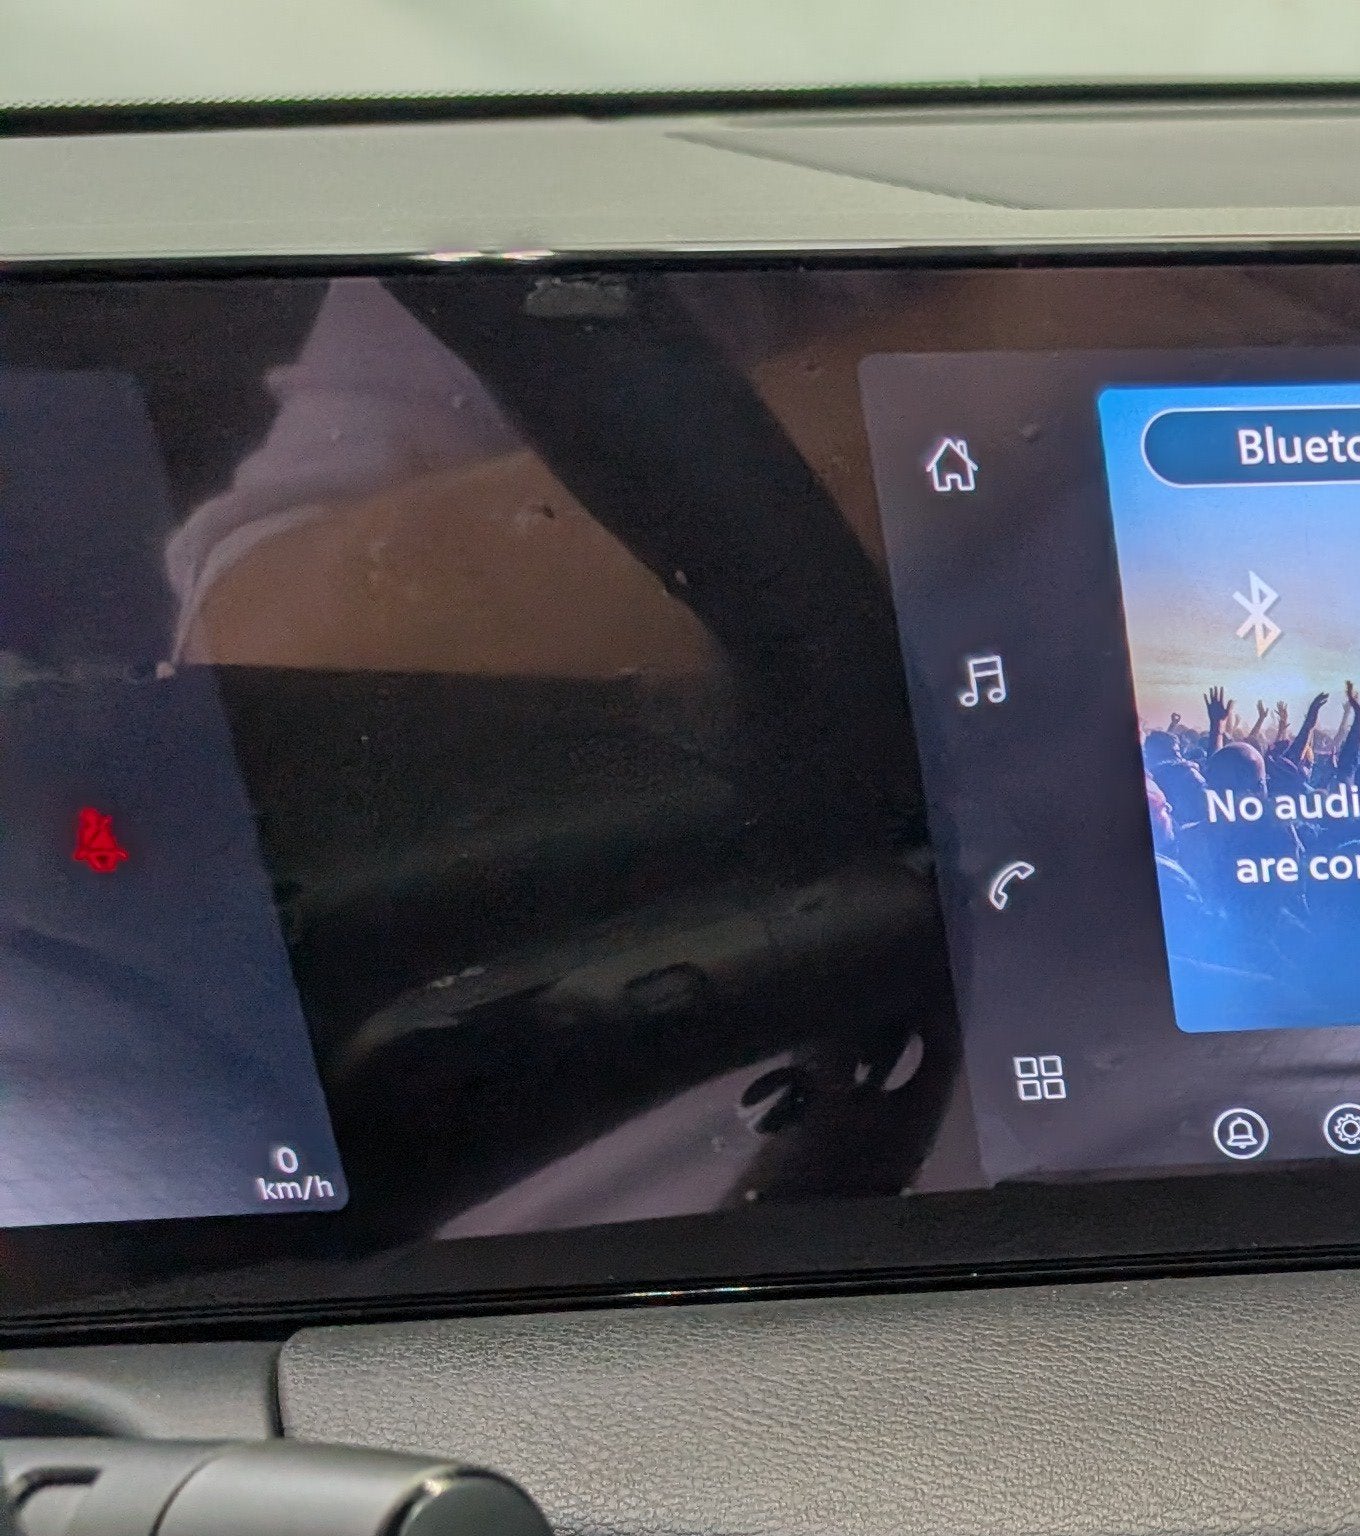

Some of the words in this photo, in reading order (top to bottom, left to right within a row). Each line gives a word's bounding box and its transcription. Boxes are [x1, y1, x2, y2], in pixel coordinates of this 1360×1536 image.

[1206, 789, 1262, 822] No
[1236, 856, 1298, 884] are
[276, 1147, 299, 1174] 0
[258, 1174, 335, 1201] km/h
